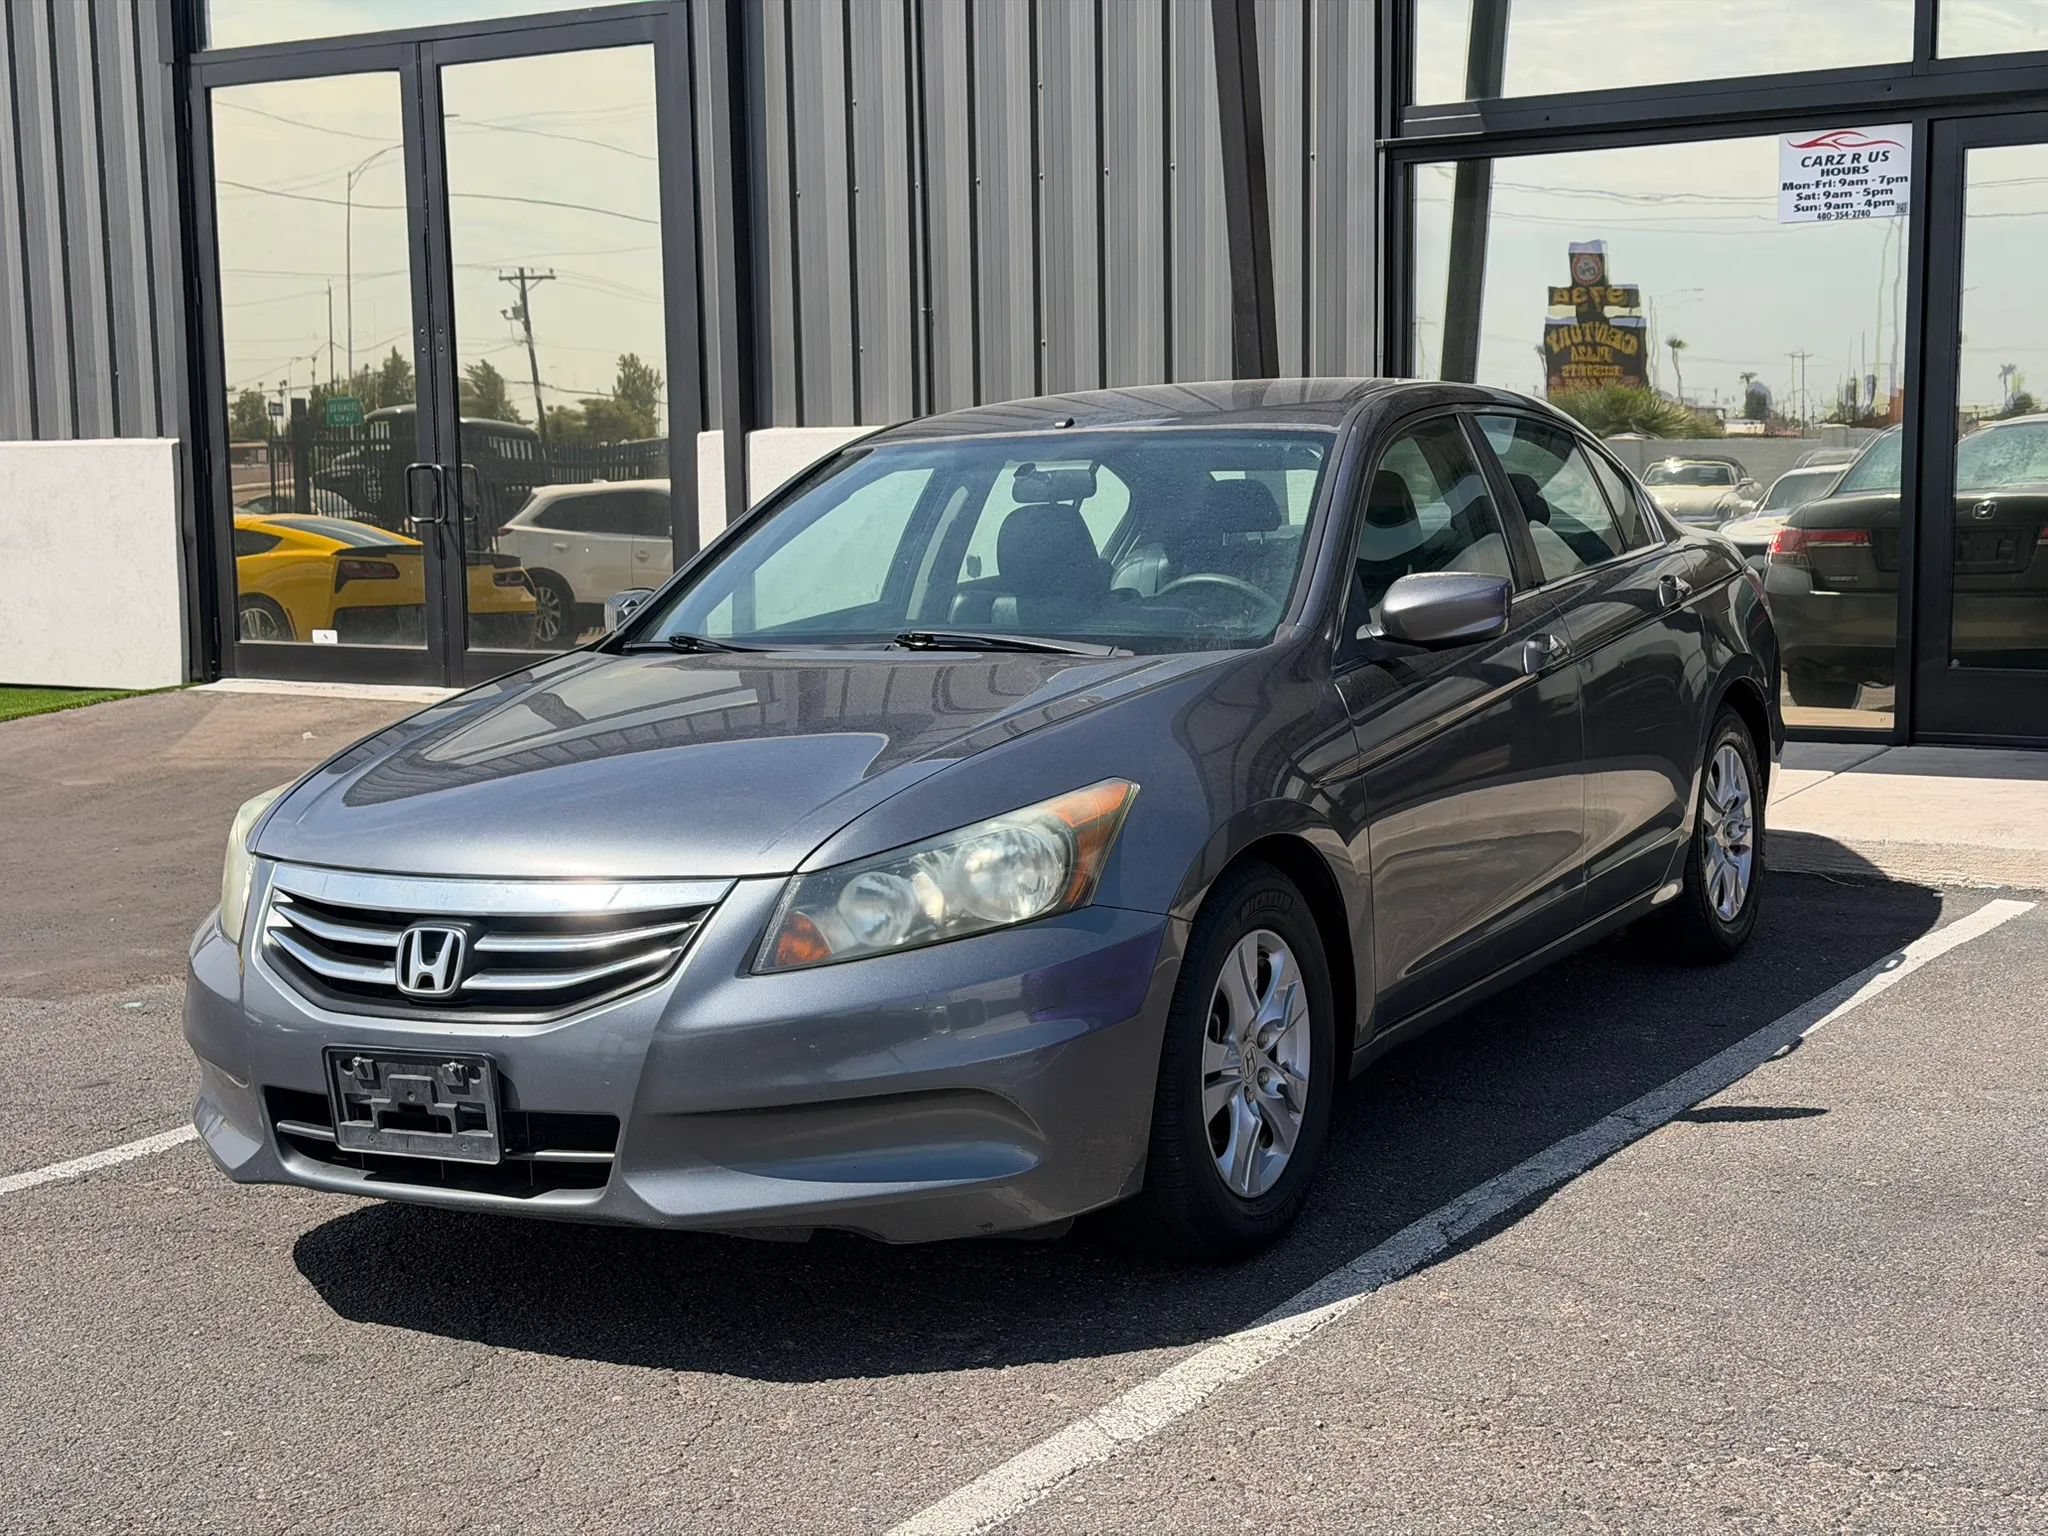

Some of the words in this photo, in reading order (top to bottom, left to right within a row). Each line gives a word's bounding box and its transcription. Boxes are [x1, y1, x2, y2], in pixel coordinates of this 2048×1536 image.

[1801, 153, 1847, 168] CARZ
[1851, 152, 1862, 165] R
[1868, 150, 1890, 163] US
[1820, 165, 1869, 177] HOURS
[1782, 180, 1837, 192] Mon-Fri:
[1838, 177, 1868, 188] 9am
[1878, 175, 1909, 187] 7pm
[1795, 190, 1821, 202] Sat:
[1822, 190, 1853, 200] 9am
[1862, 187, 1893, 199] 5pm
[1793, 202, 1822, 213] Sun:
[1824, 201, 1854, 211] 9am
[1864, 198, 1895, 210] 4pm
[1816, 209, 1871, 220] 480-354-2740
